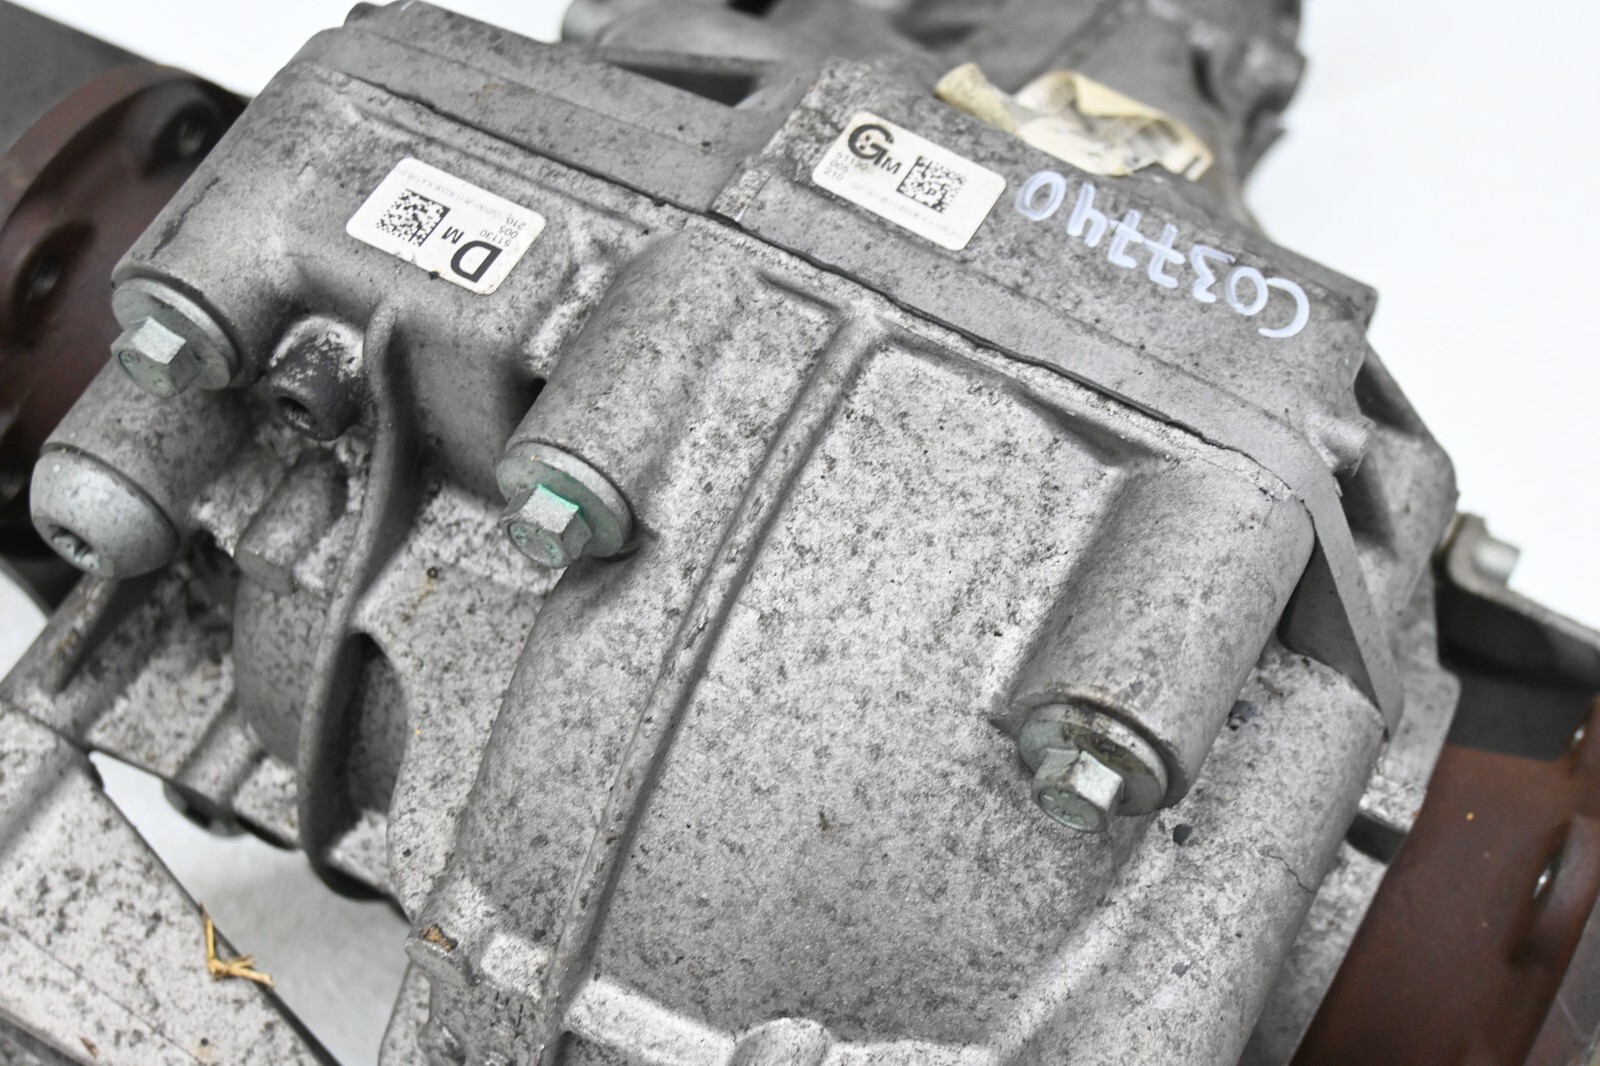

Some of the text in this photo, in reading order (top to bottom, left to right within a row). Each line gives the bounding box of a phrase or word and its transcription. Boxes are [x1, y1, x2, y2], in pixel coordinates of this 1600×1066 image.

[823, 167, 845, 182] 210
[830, 160, 849, 174] 005
[506, 216, 527, 231] 210
[500, 225, 519, 239] 005
[1014, 170, 1309, 338] C037740
